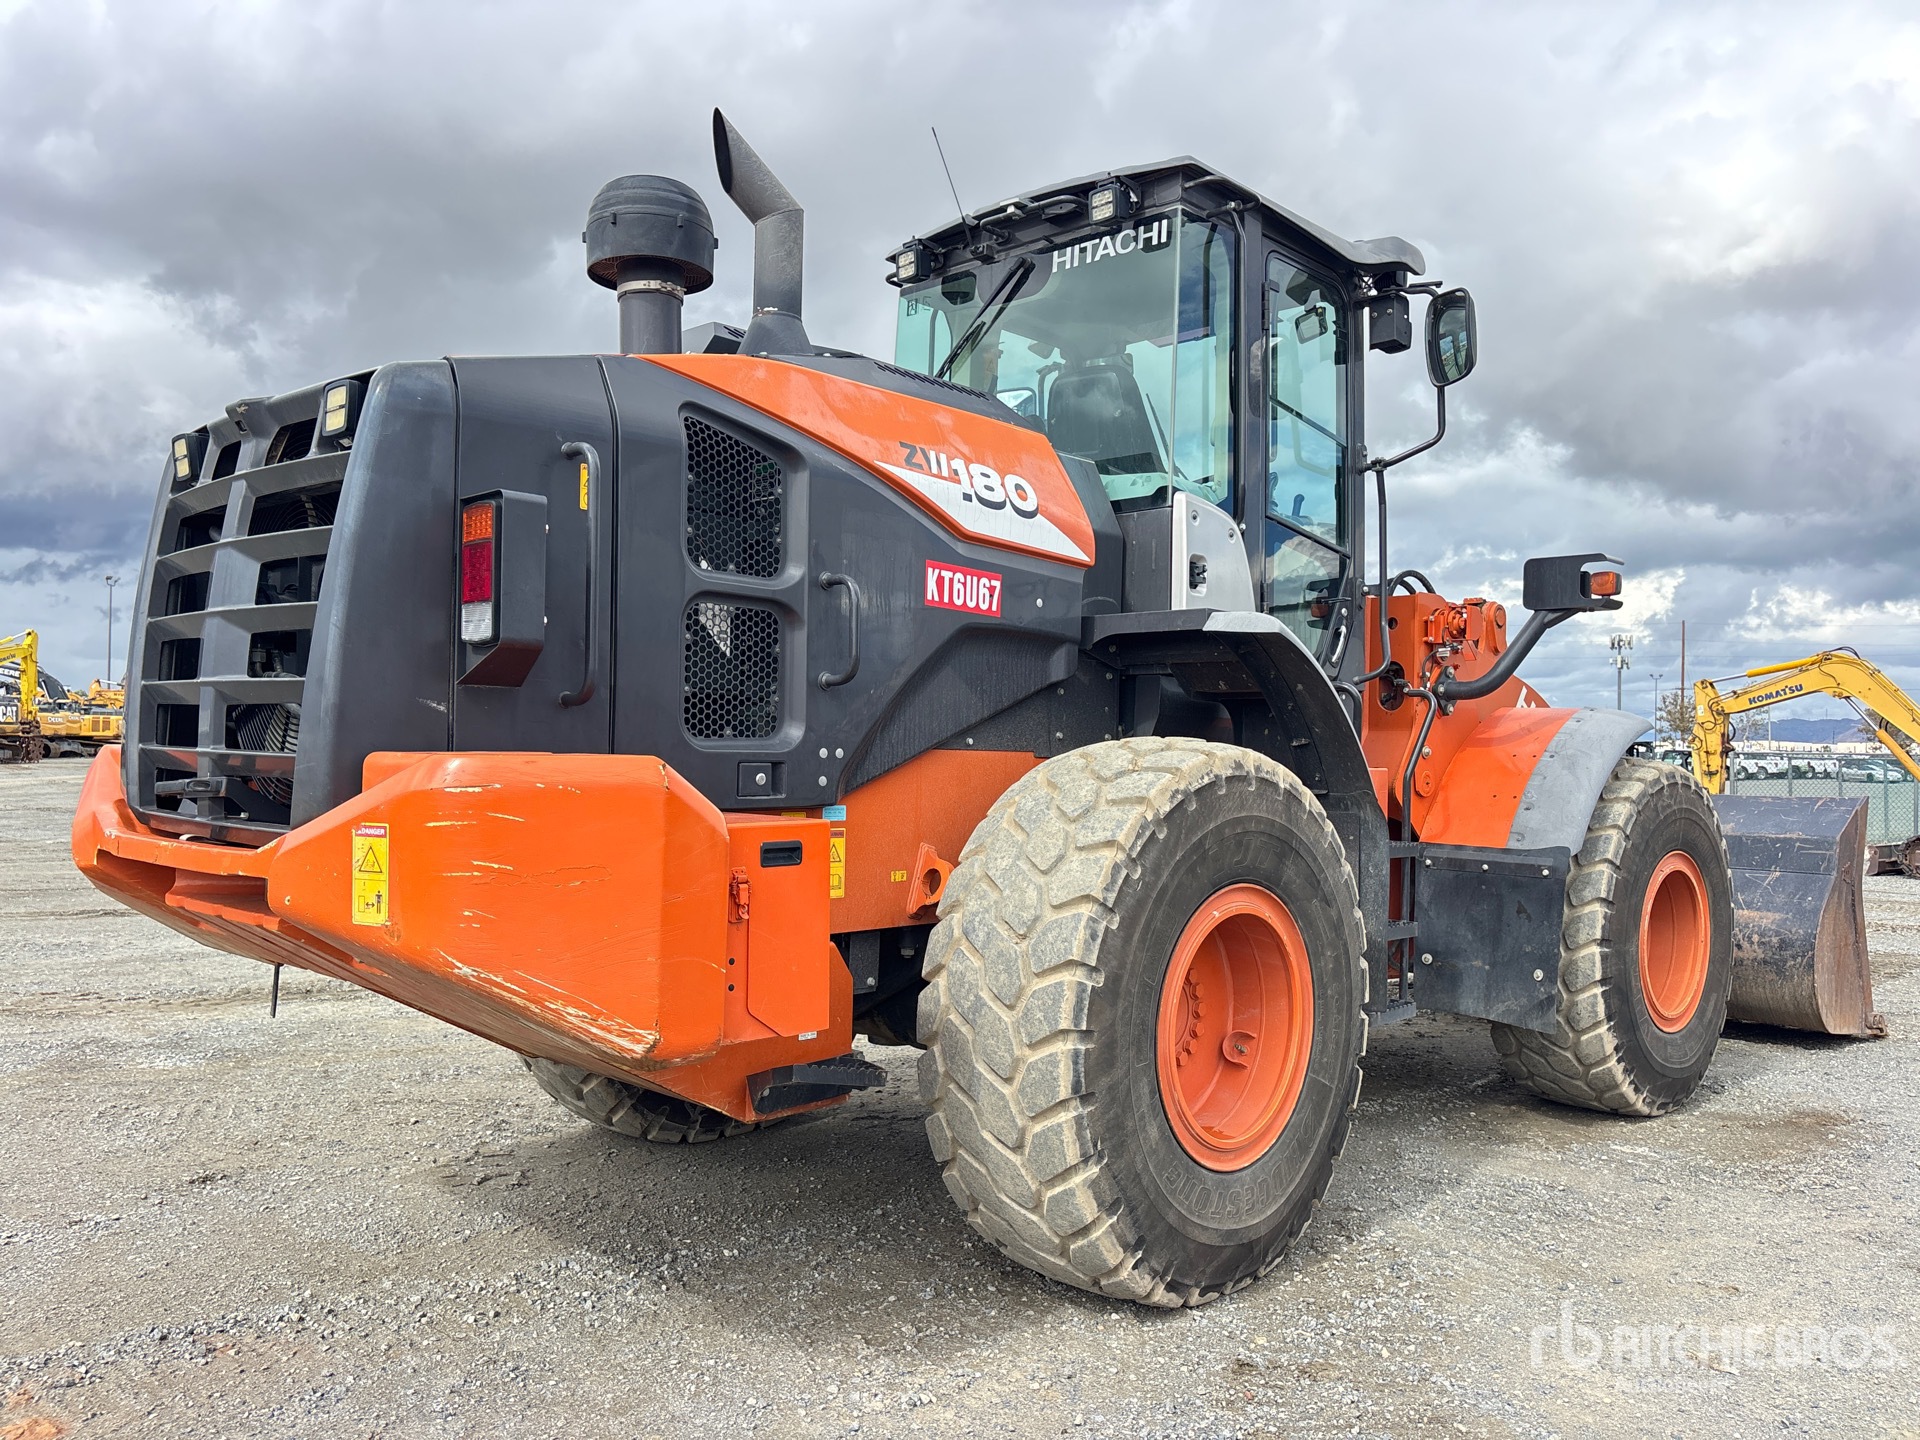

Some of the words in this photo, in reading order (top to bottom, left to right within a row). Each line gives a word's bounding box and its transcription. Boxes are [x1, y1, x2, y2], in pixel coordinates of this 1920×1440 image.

[1052, 219, 1168, 273] HITACHI
[927, 567, 1001, 612] KT6U67
[0, 668, 20, 677] EERE
[1748, 683, 1804, 705] KOMATSU
[0, 706, 17, 722] CAT
